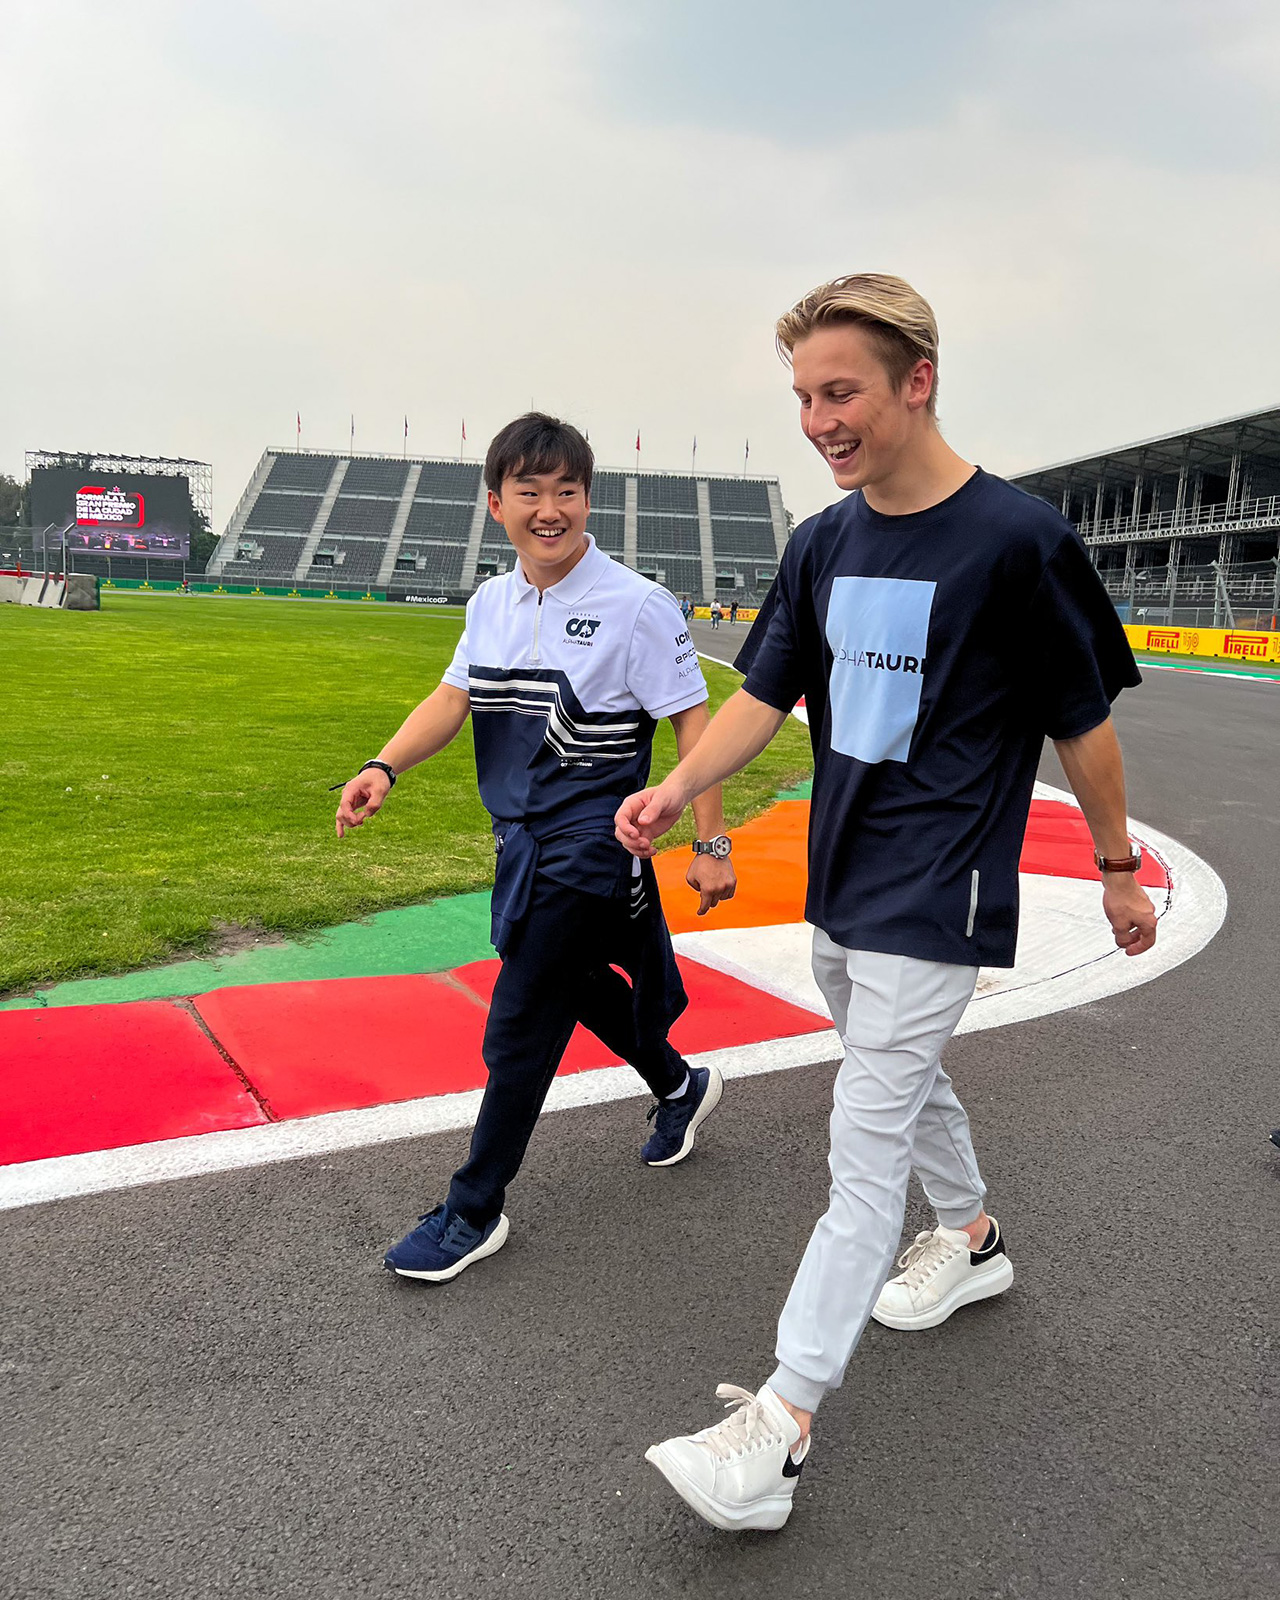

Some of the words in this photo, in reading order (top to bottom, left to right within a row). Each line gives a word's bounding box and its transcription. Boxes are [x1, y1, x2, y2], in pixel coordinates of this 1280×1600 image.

[76, 493, 119, 502] FORMULA
[103, 501, 136, 509] PREMIO
[89, 506, 101, 514] LA
[101, 507, 133, 515] CIUDAD
[405, 595, 448, 604] #MexicoGP
[1146, 630, 1180, 649] PIRELLI
[1223, 634, 1269, 657] PIRELLI
